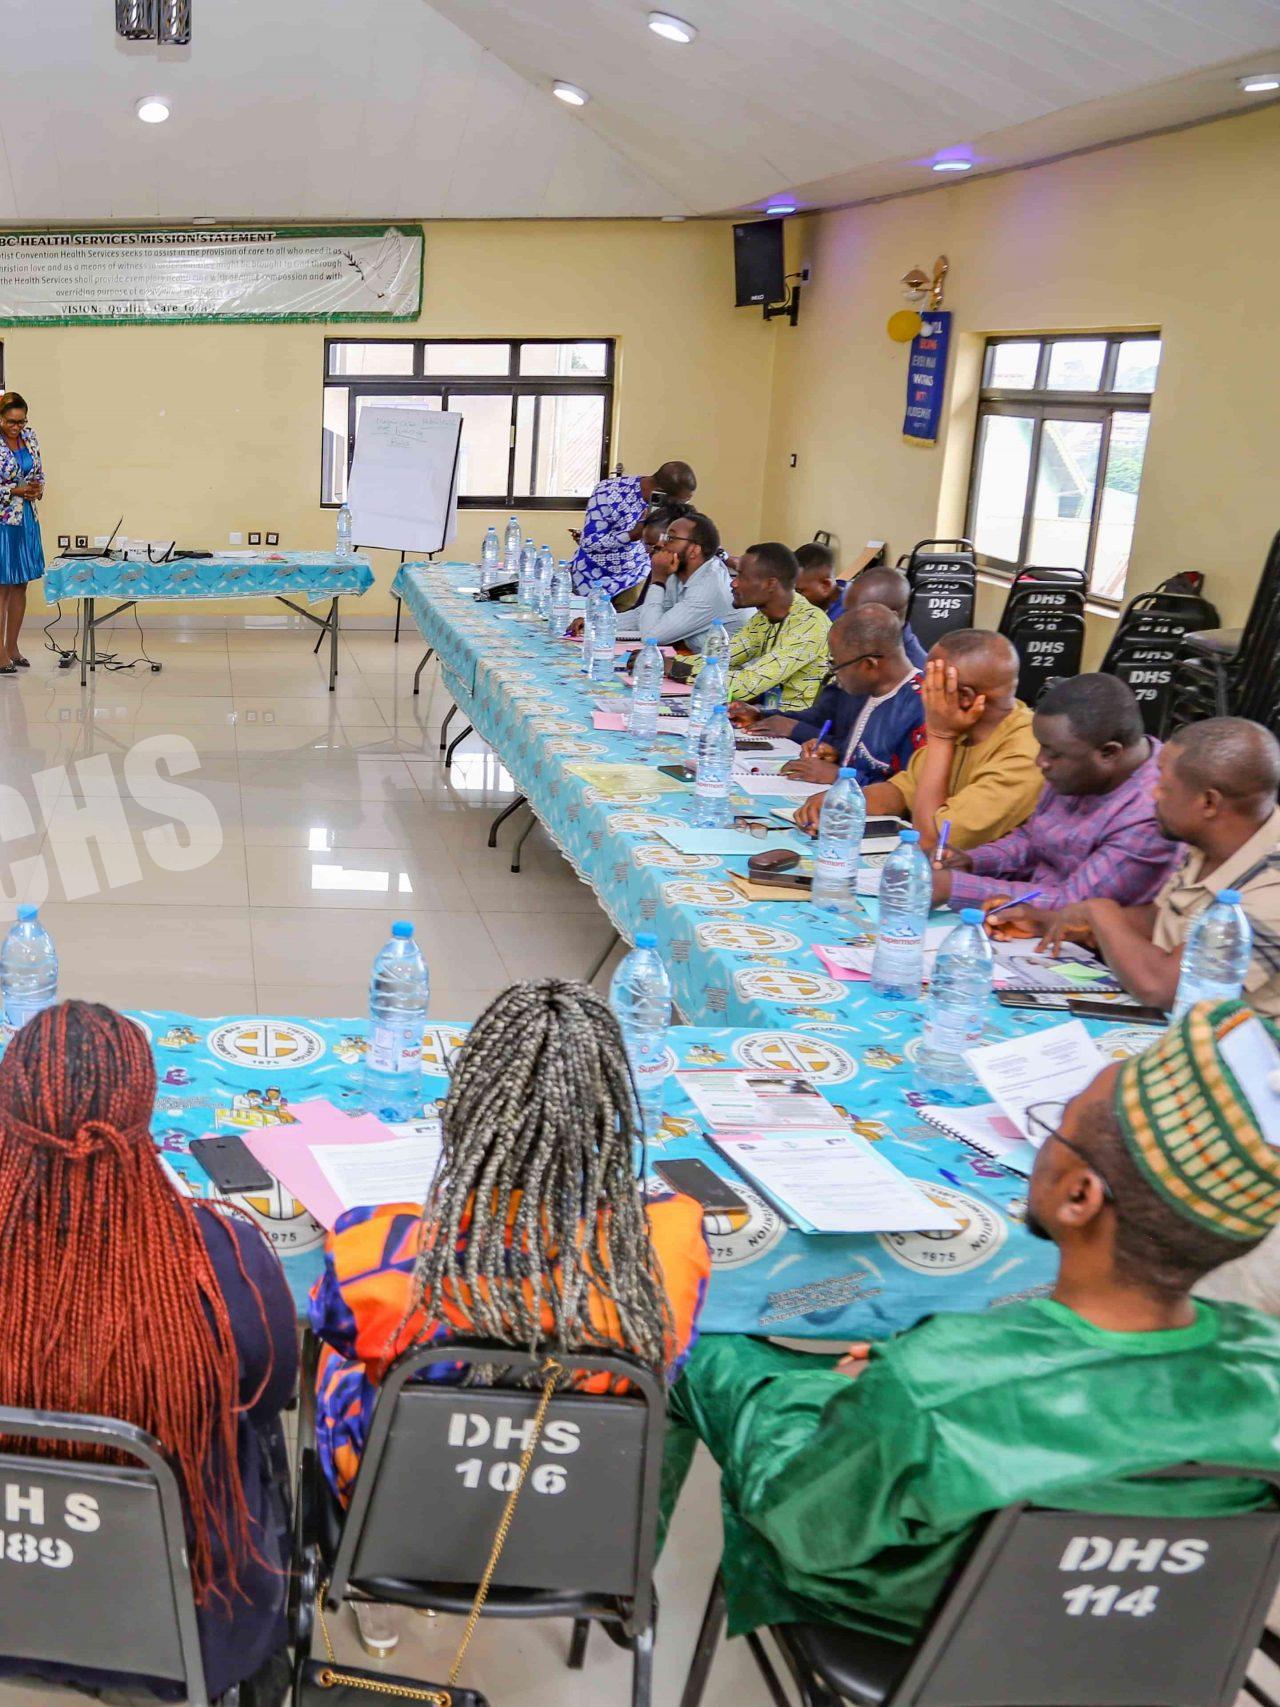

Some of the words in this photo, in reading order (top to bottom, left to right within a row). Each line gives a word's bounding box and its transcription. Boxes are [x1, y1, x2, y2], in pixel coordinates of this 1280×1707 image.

[21, 236, 70, 246] HEALTH
[75, 235, 136, 245] SERVICES
[140, 234, 196, 244] MISSION
[200, 233, 274, 243] STATEMENT
[15, 250, 59, 260] Convention
[60, 249, 86, 259] Health
[88, 250, 120, 258] Services
[201, 247, 237, 257] provision
[0, 277, 13, 285] the
[14, 276, 40, 285] Health
[41, 275, 73, 284] Services
[928, 598, 962, 609] DHS
[1027, 594, 1067, 605] DHS
[930, 609, 950, 619] 54
[1026, 641, 1065, 654] DHS
[1030, 655, 1055, 667] 22
[1128, 670, 1172, 684] DHS
[1134, 688, 1158, 701] 79
[268, 1232, 297, 1243] 975
[921, 1251, 957, 1262] 1975
[447, 1412, 581, 1455] DHS
[454, 1458, 568, 1495] 106
[1058, 1535, 1210, 1575] DHS
[1062, 1584, 1160, 1617] 114
